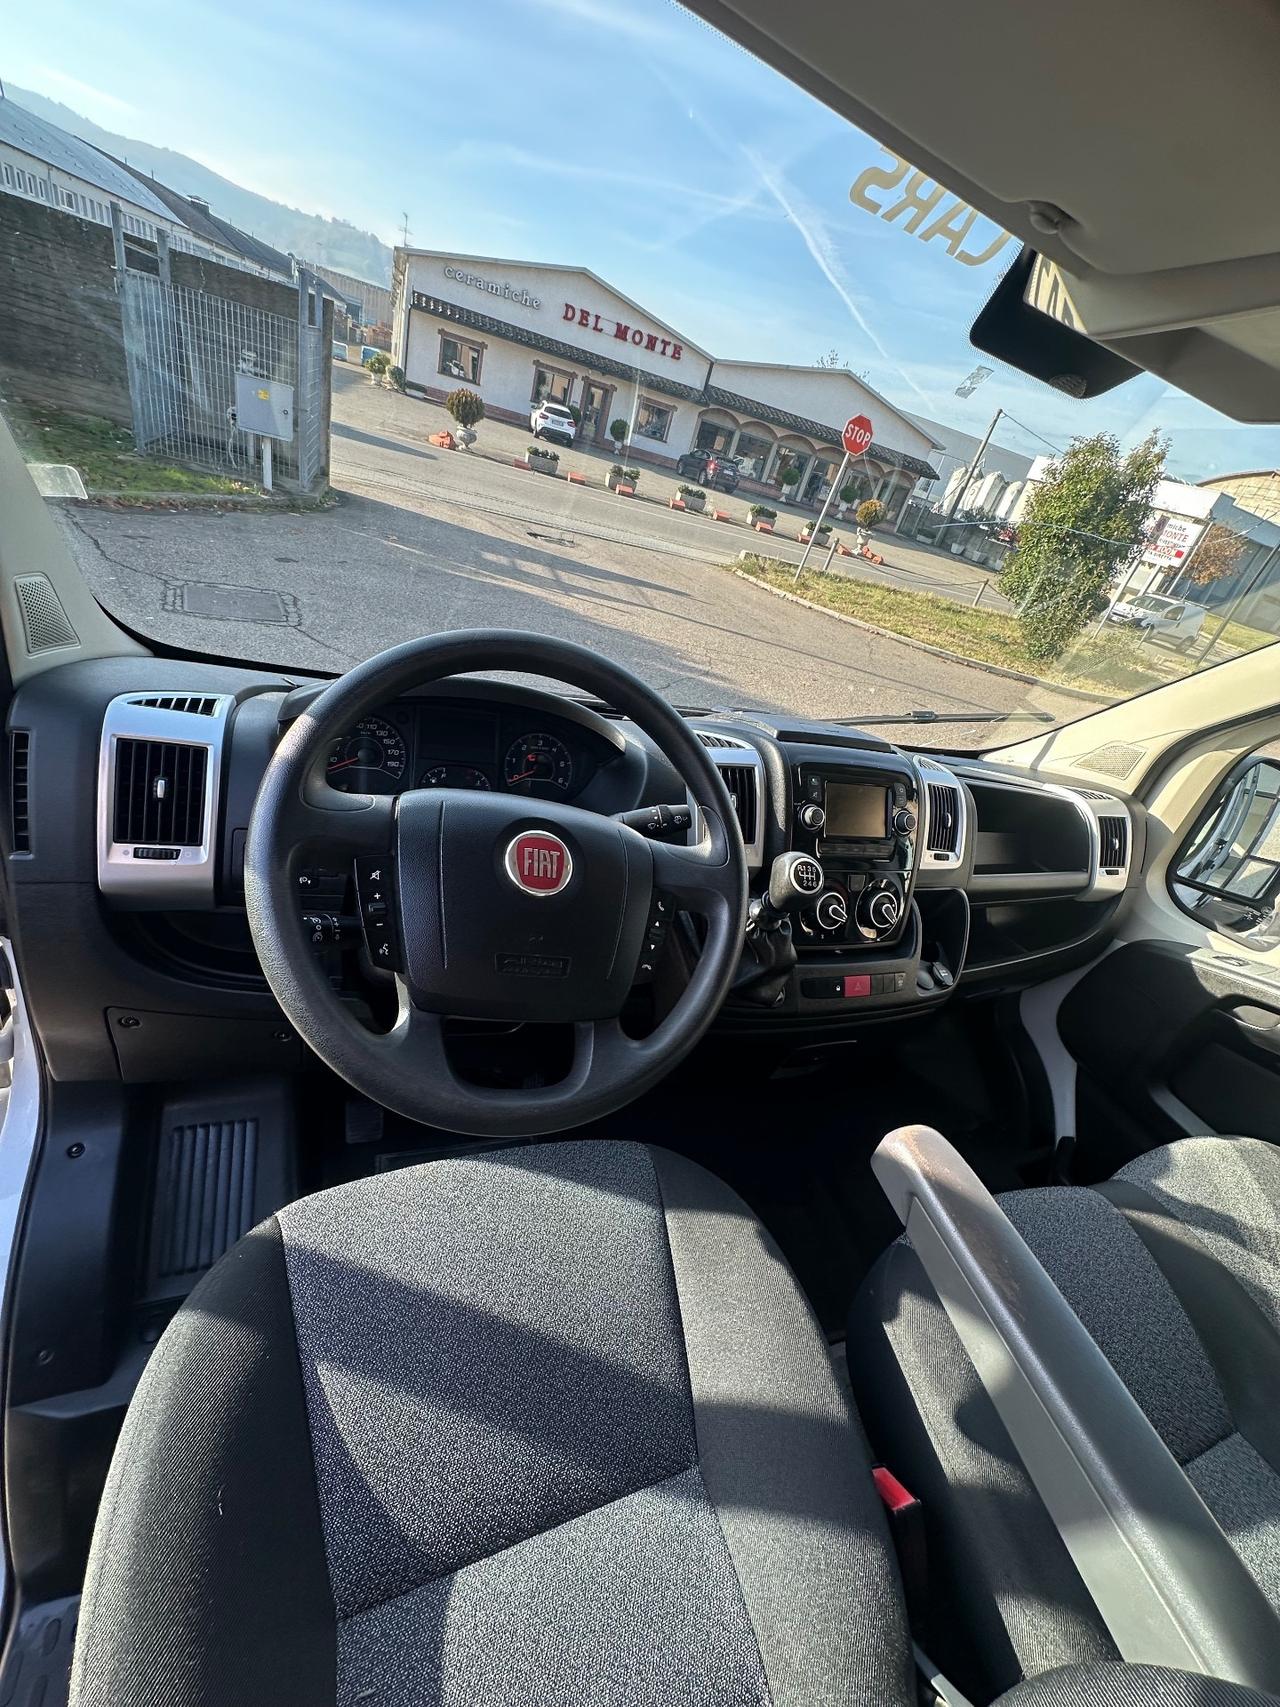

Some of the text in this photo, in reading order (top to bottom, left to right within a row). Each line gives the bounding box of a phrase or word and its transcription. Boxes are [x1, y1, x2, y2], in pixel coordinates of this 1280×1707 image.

[444, 265, 542, 310] ceramiche
[562, 303, 684, 360] DEL MONTE
[845, 424, 871, 446] STOP
[523, 847, 560, 879] FIAT
